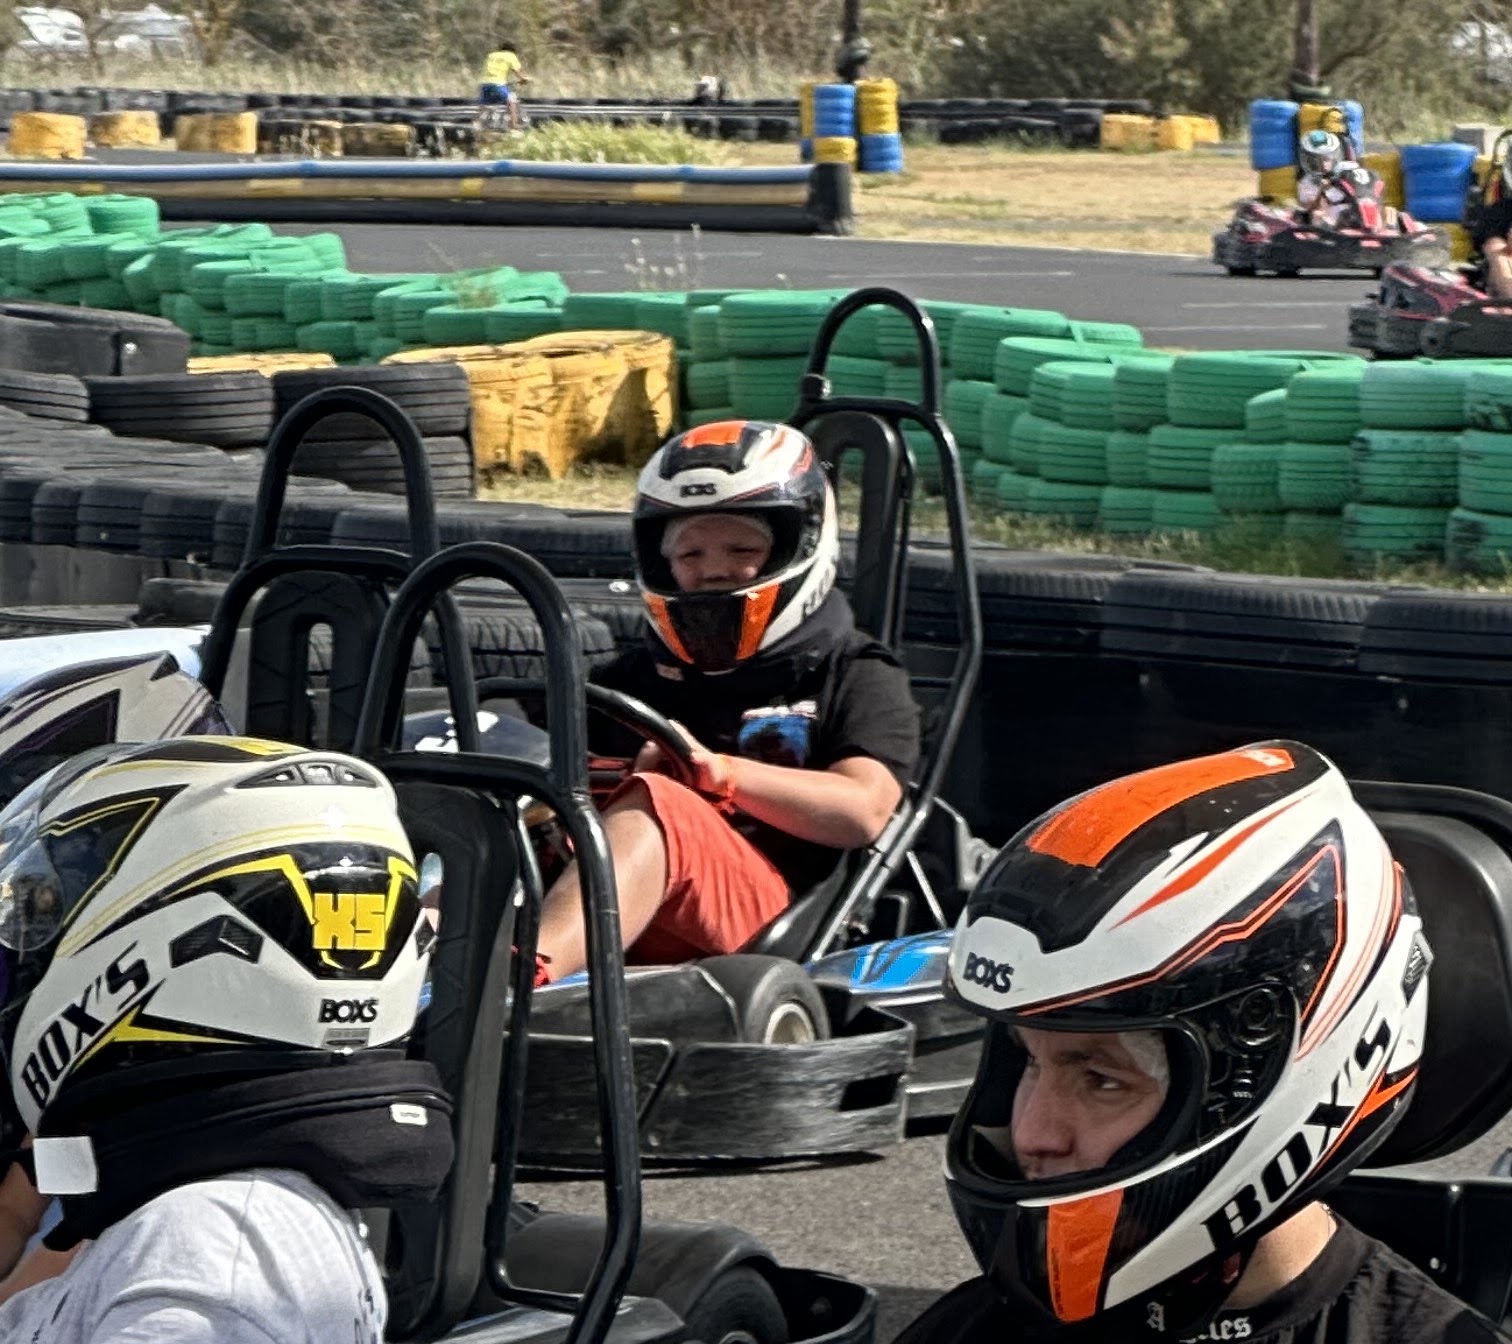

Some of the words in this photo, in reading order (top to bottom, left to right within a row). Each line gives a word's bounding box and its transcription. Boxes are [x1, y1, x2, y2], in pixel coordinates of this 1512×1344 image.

[312, 893, 386, 950] XS
[20, 939, 149, 1110] BOX'S
[1200, 1000, 1392, 1251] BOX'S
